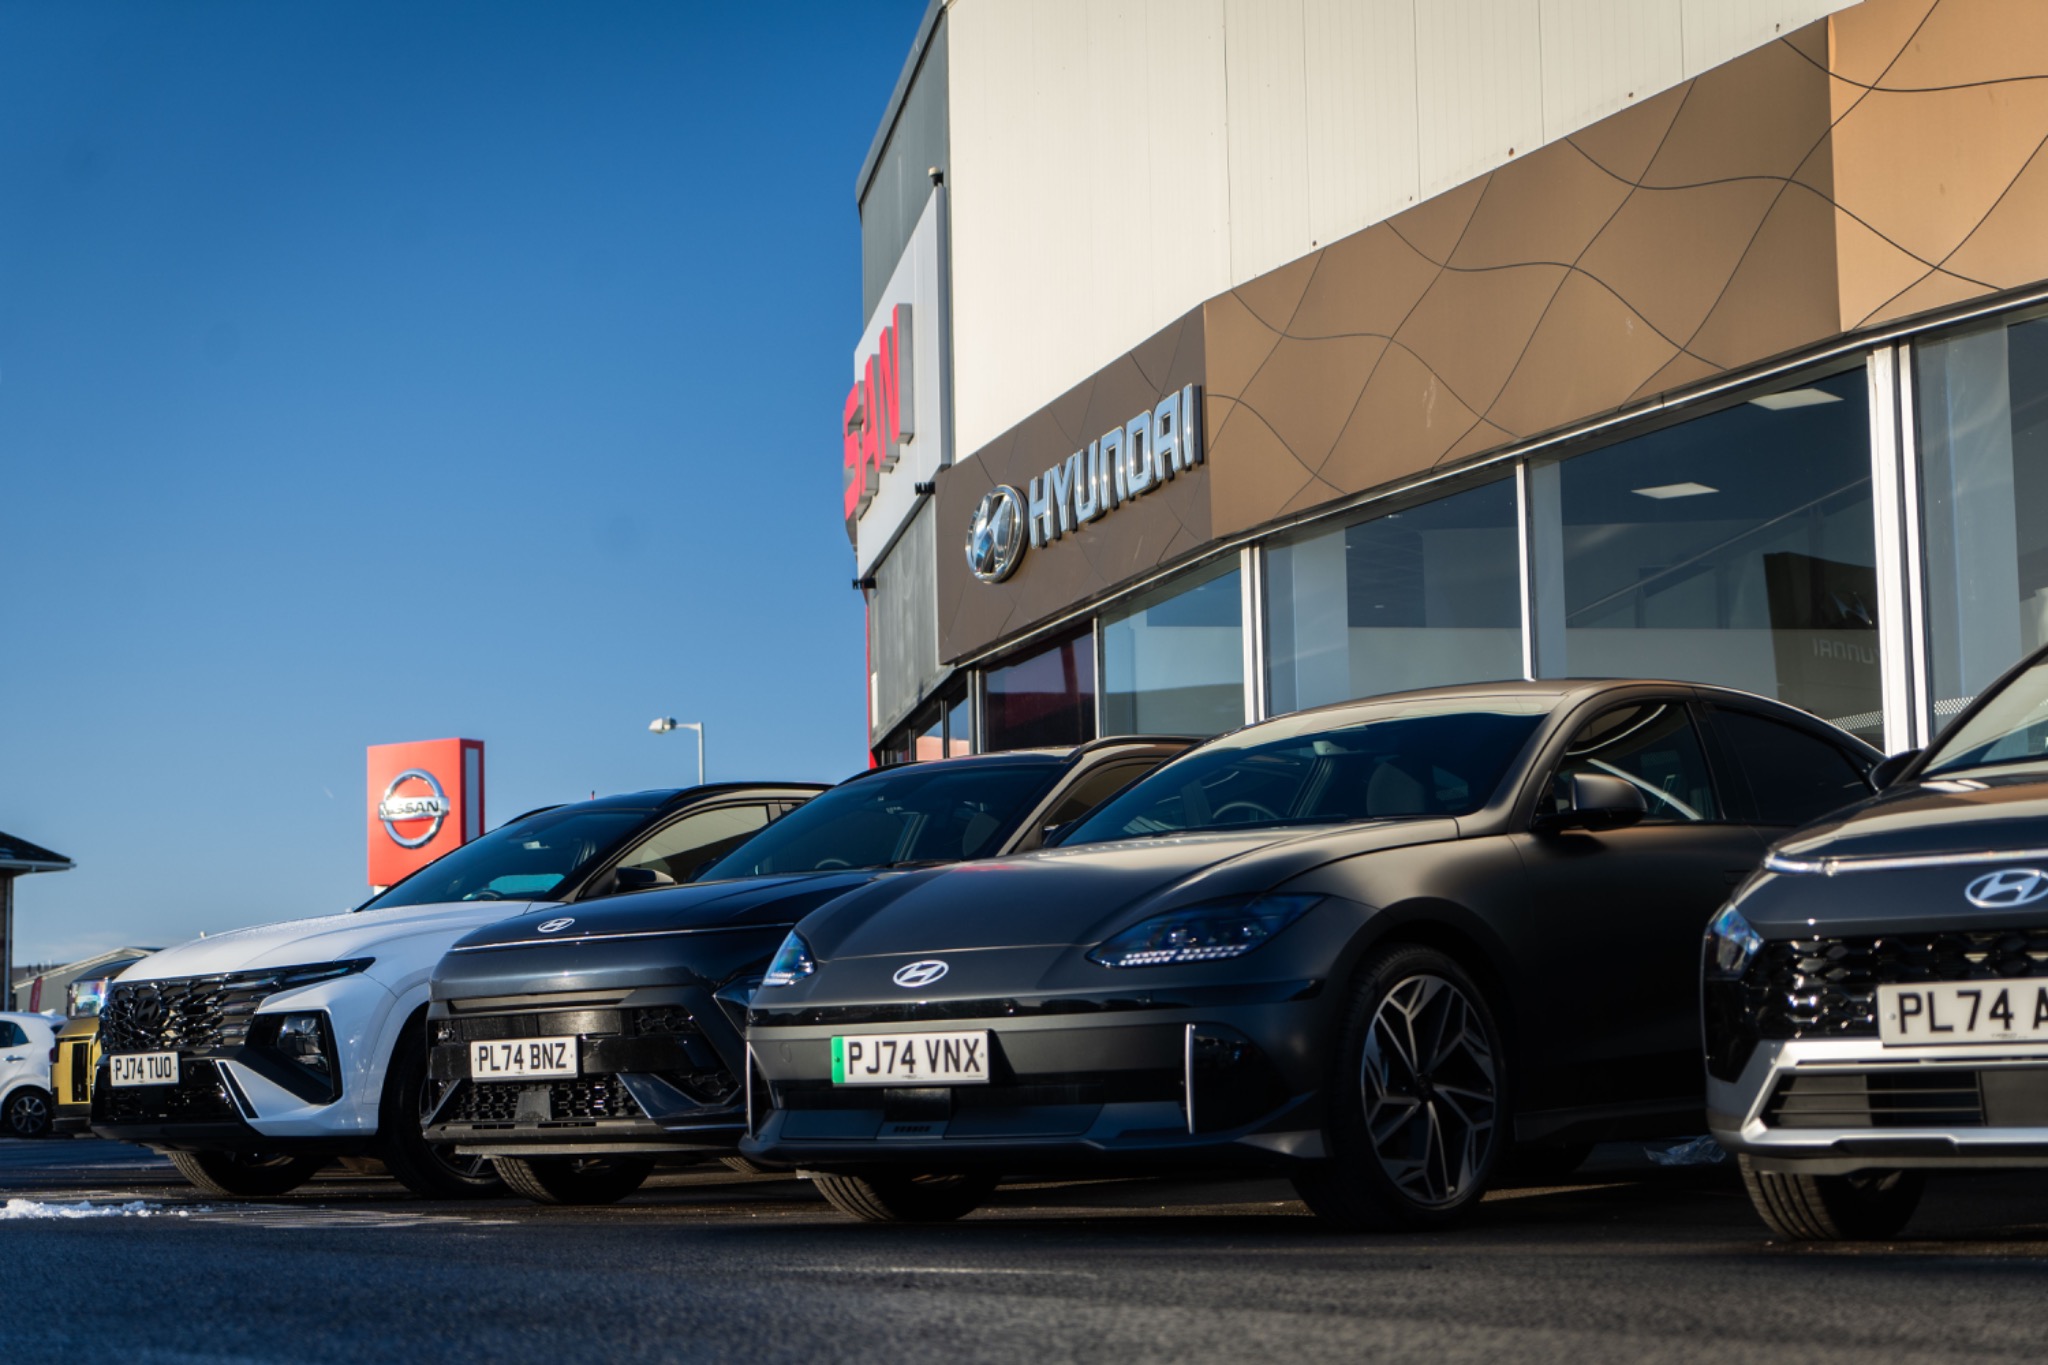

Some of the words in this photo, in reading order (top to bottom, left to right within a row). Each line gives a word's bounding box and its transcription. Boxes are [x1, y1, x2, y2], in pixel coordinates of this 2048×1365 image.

[1029, 383, 1196, 550] HYUNDAI
[1898, 988, 2014, 1034] PL74
[115, 1057, 143, 1080] PJ74
[147, 1056, 171, 1079] TUO
[478, 1044, 524, 1072] PL74
[529, 1042, 567, 1070] BNZ
[847, 1040, 916, 1075] PJ74
[925, 1038, 981, 1073] VNX
